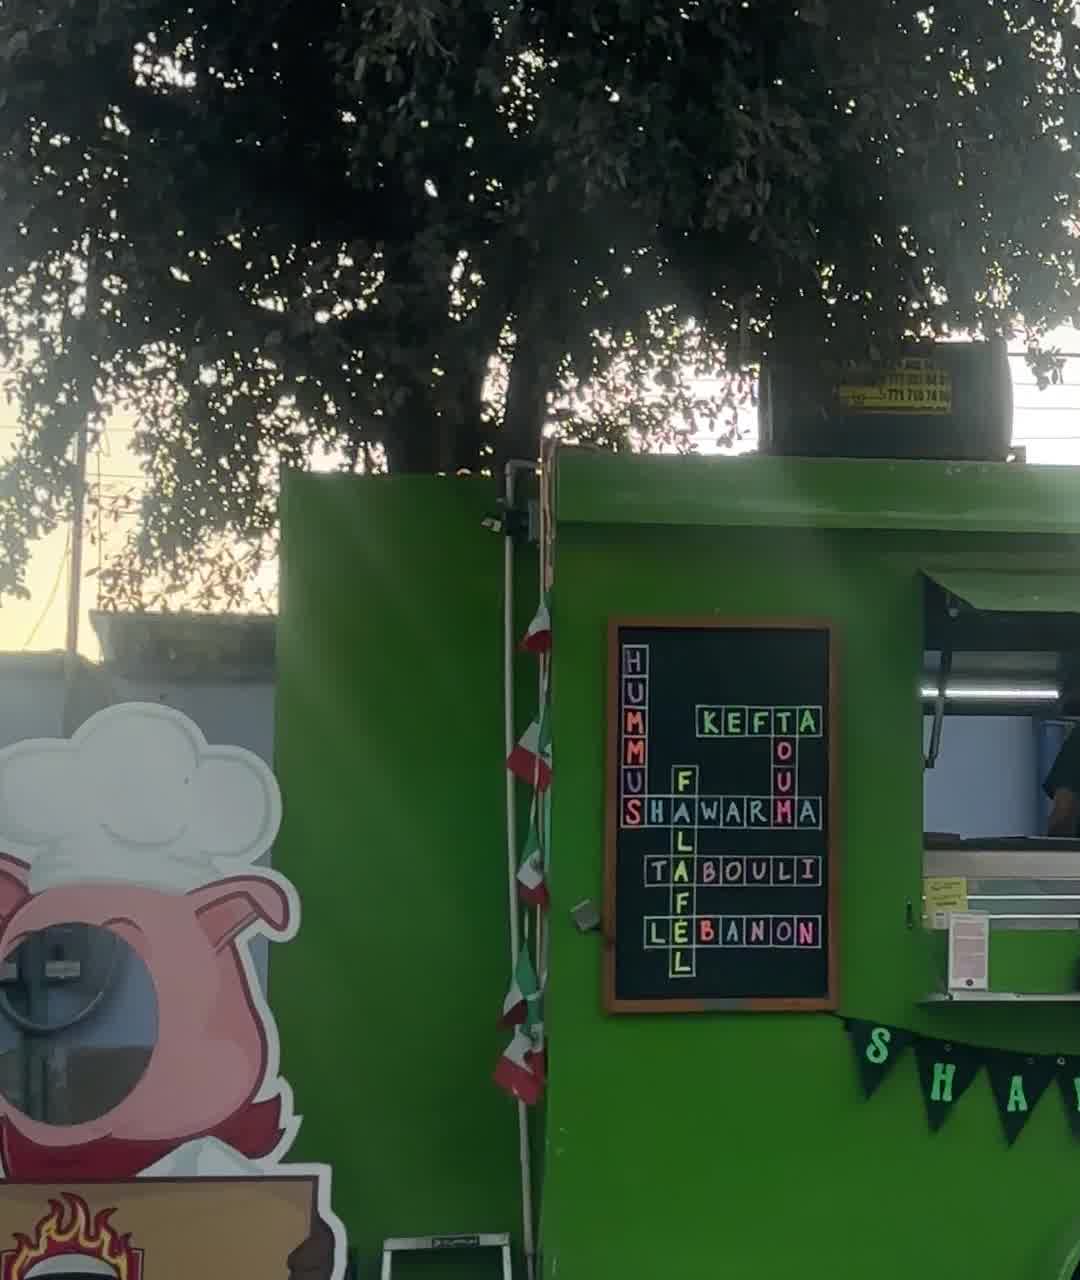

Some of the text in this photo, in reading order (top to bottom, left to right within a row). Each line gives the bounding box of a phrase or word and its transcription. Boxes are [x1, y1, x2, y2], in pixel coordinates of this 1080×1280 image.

[704, 710, 817, 735] KEFTA
[625, 649, 645, 825] HUMMUS
[625, 798, 817, 825] SHAWARMA
[650, 857, 815, 885] TABOULI
[674, 770, 693, 973] FALAFEL
[649, 918, 815, 945] LEBANON
